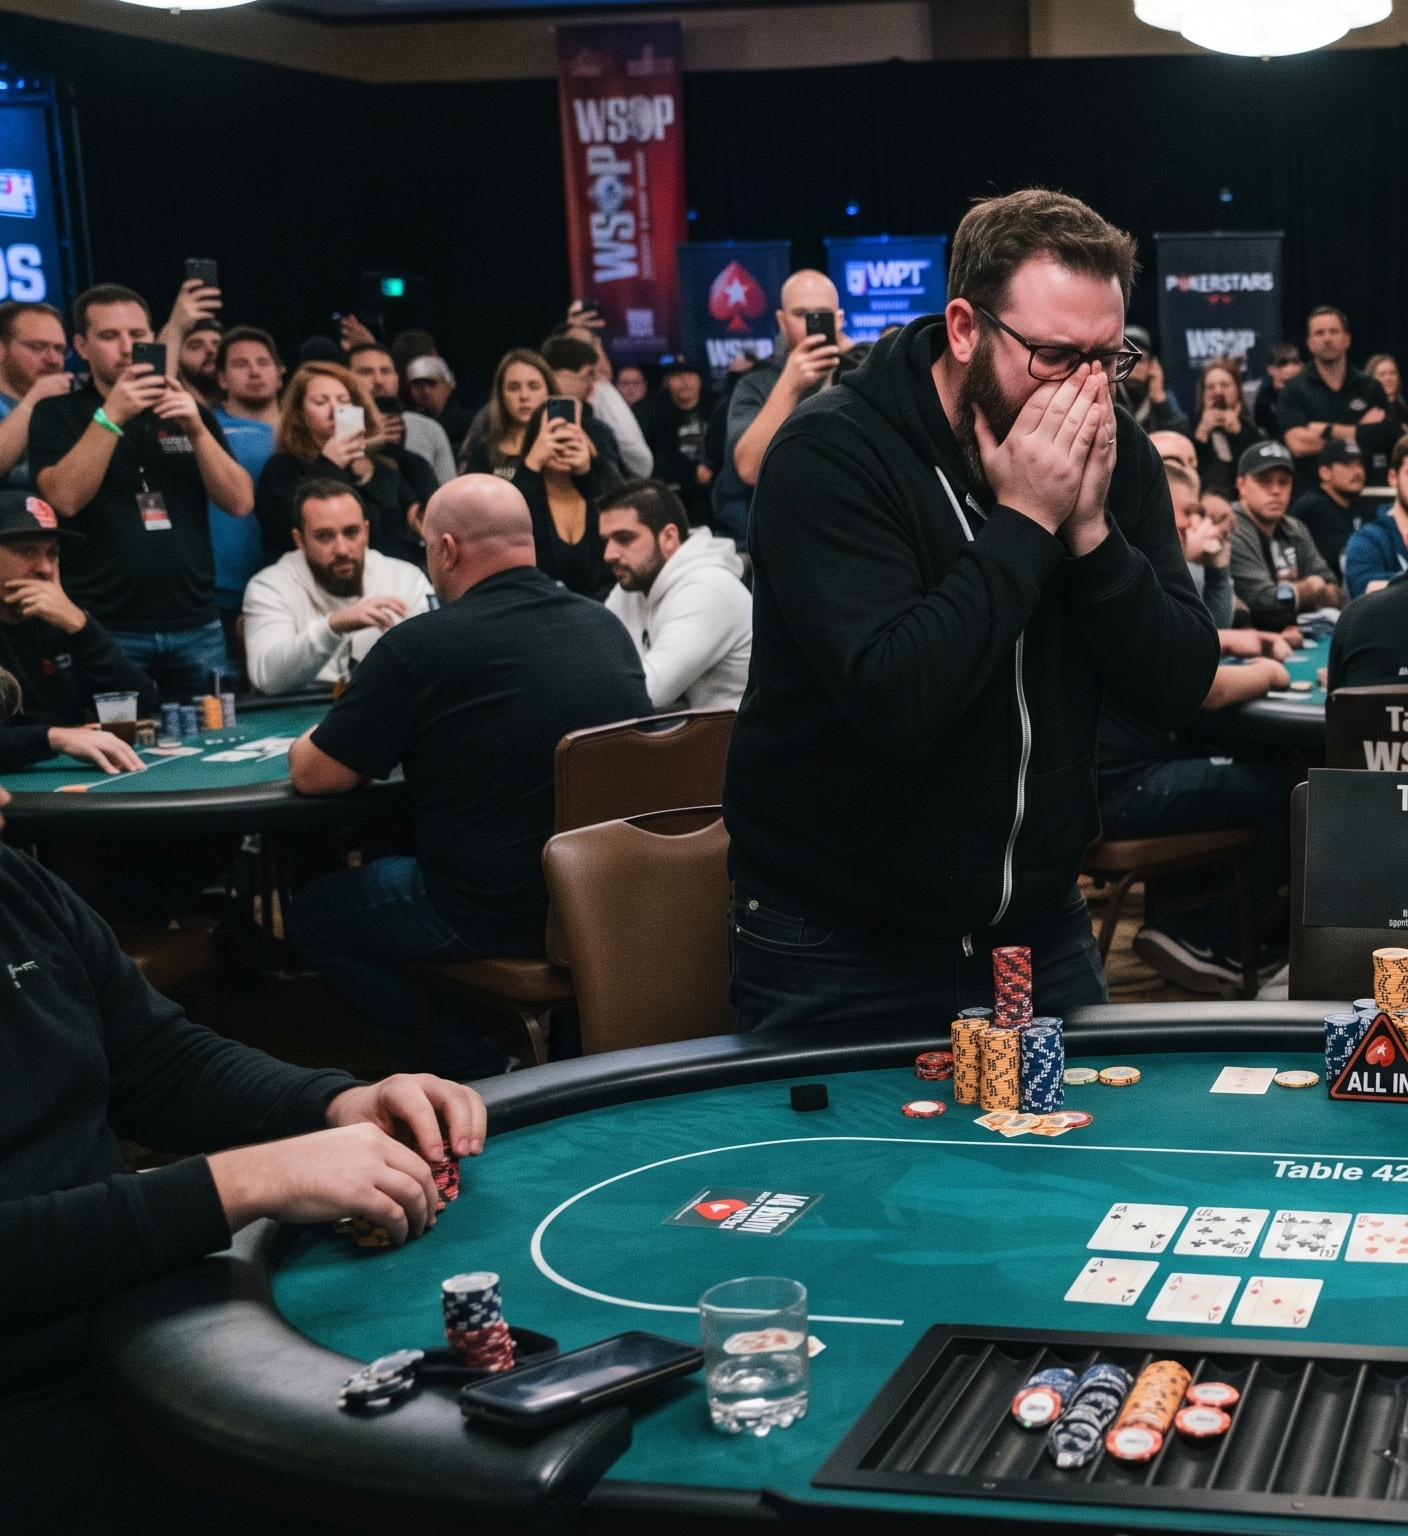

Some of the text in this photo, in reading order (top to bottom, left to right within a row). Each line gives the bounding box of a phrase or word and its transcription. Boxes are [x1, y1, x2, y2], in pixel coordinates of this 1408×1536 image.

[573, 95, 676, 143] WSOP
[866, 259, 932, 288] WPT
[1346, 1071, 1387, 1093] ALL
[1273, 1160, 1364, 1181] Table
